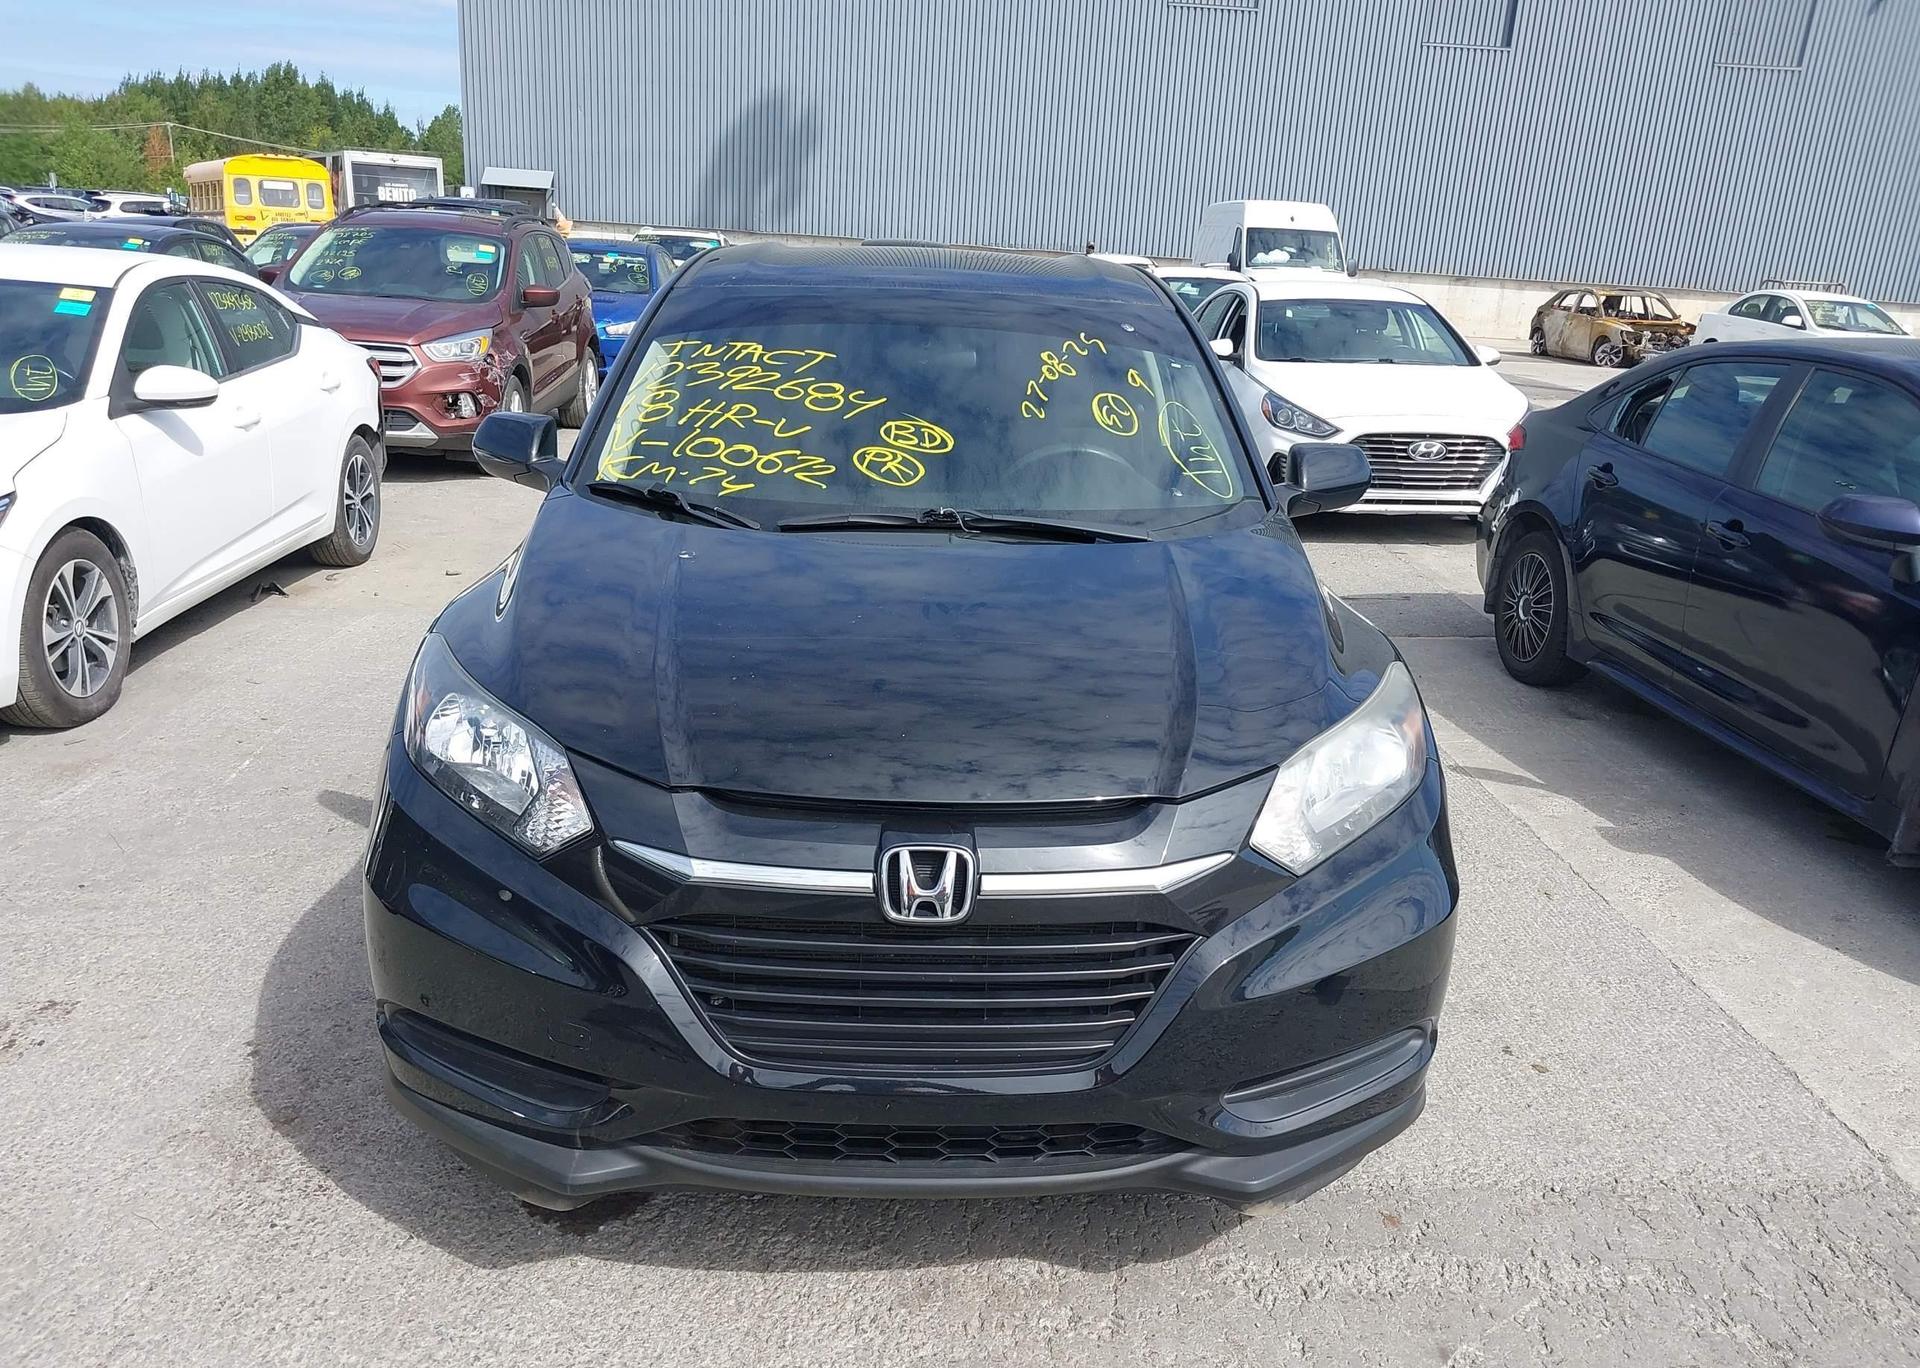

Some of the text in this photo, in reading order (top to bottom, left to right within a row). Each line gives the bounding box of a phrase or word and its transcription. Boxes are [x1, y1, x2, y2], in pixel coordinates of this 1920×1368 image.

[662, 340, 837, 374] INTACT
[678, 399, 812, 438] HR-V
[889, 421, 943, 450] BD
